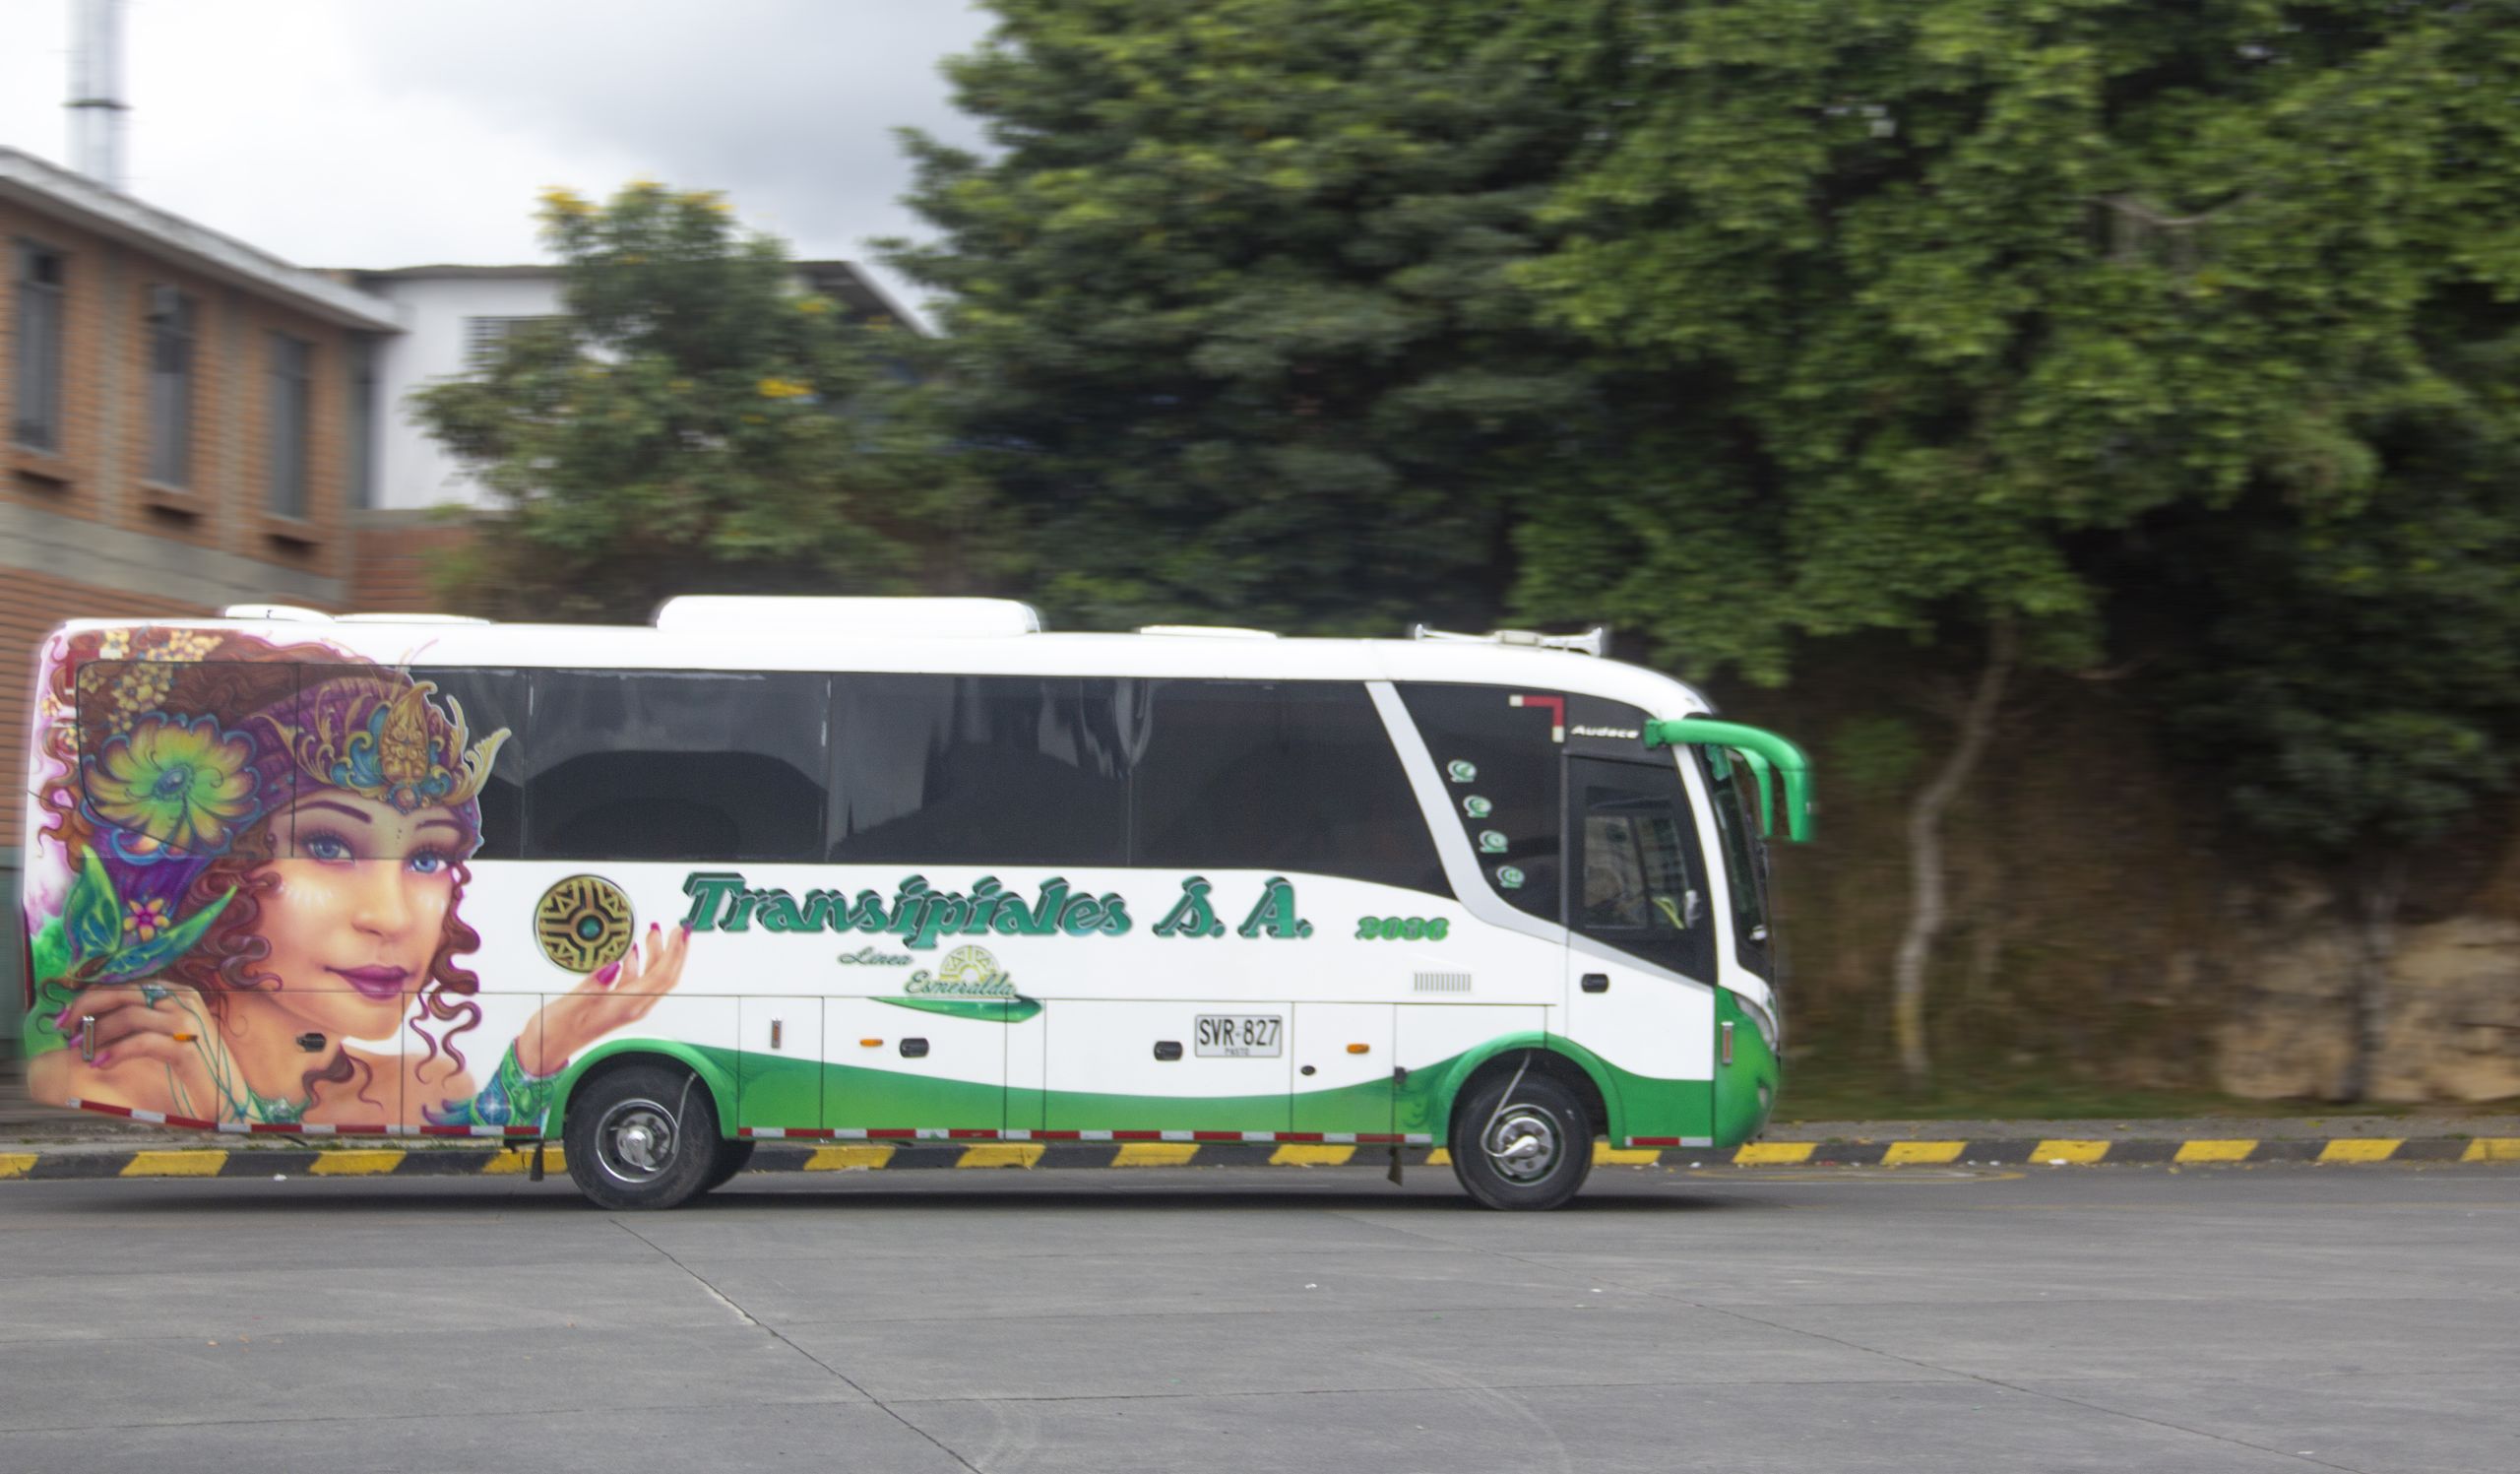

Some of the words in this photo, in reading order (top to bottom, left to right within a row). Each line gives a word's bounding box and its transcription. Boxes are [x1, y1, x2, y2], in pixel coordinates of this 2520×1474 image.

[1571, 725, 1640, 739] Audace
[681, 872, 1132, 949] Transipiales
[1152, 876, 1225, 938] S.
[1237, 876, 1313, 939] A.
[904, 970, 1017, 996] Esmeralda
